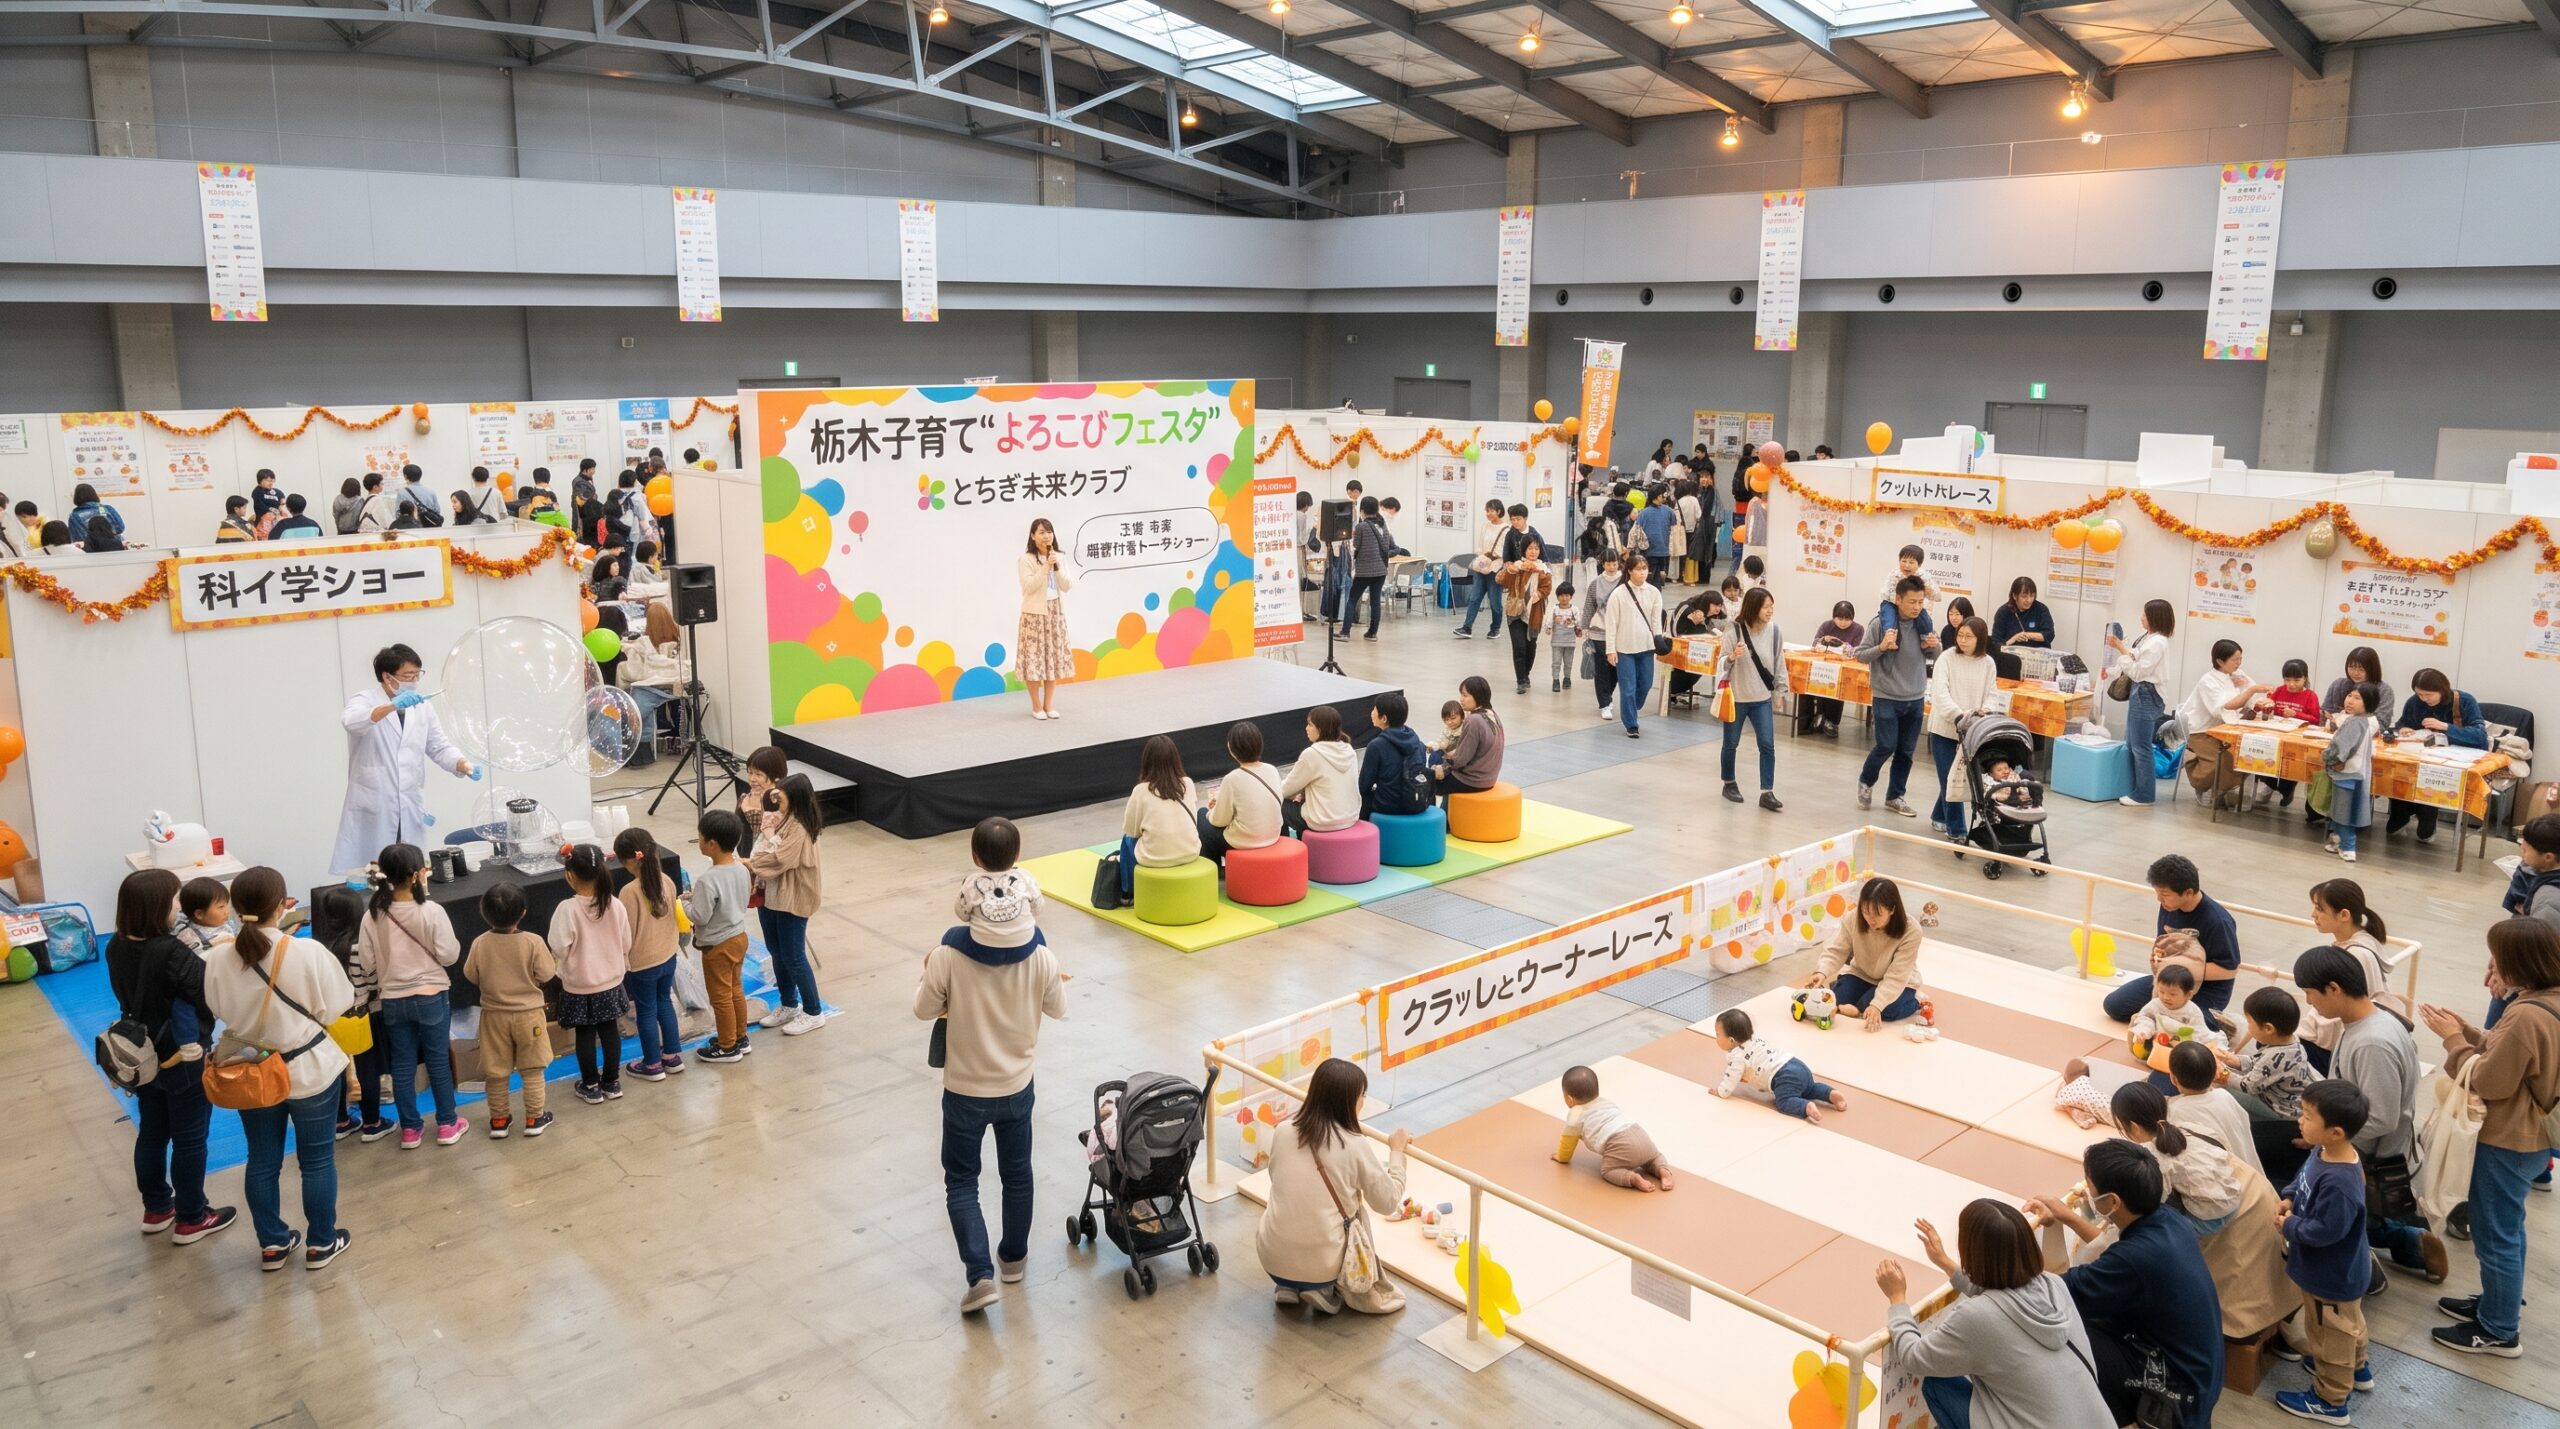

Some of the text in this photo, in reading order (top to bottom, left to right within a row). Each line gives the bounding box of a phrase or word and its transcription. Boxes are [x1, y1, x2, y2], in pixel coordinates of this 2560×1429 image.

[953, 464, 1132, 505] とちぎ未来クラブ
[197, 564, 425, 611] 科イ学ショー
